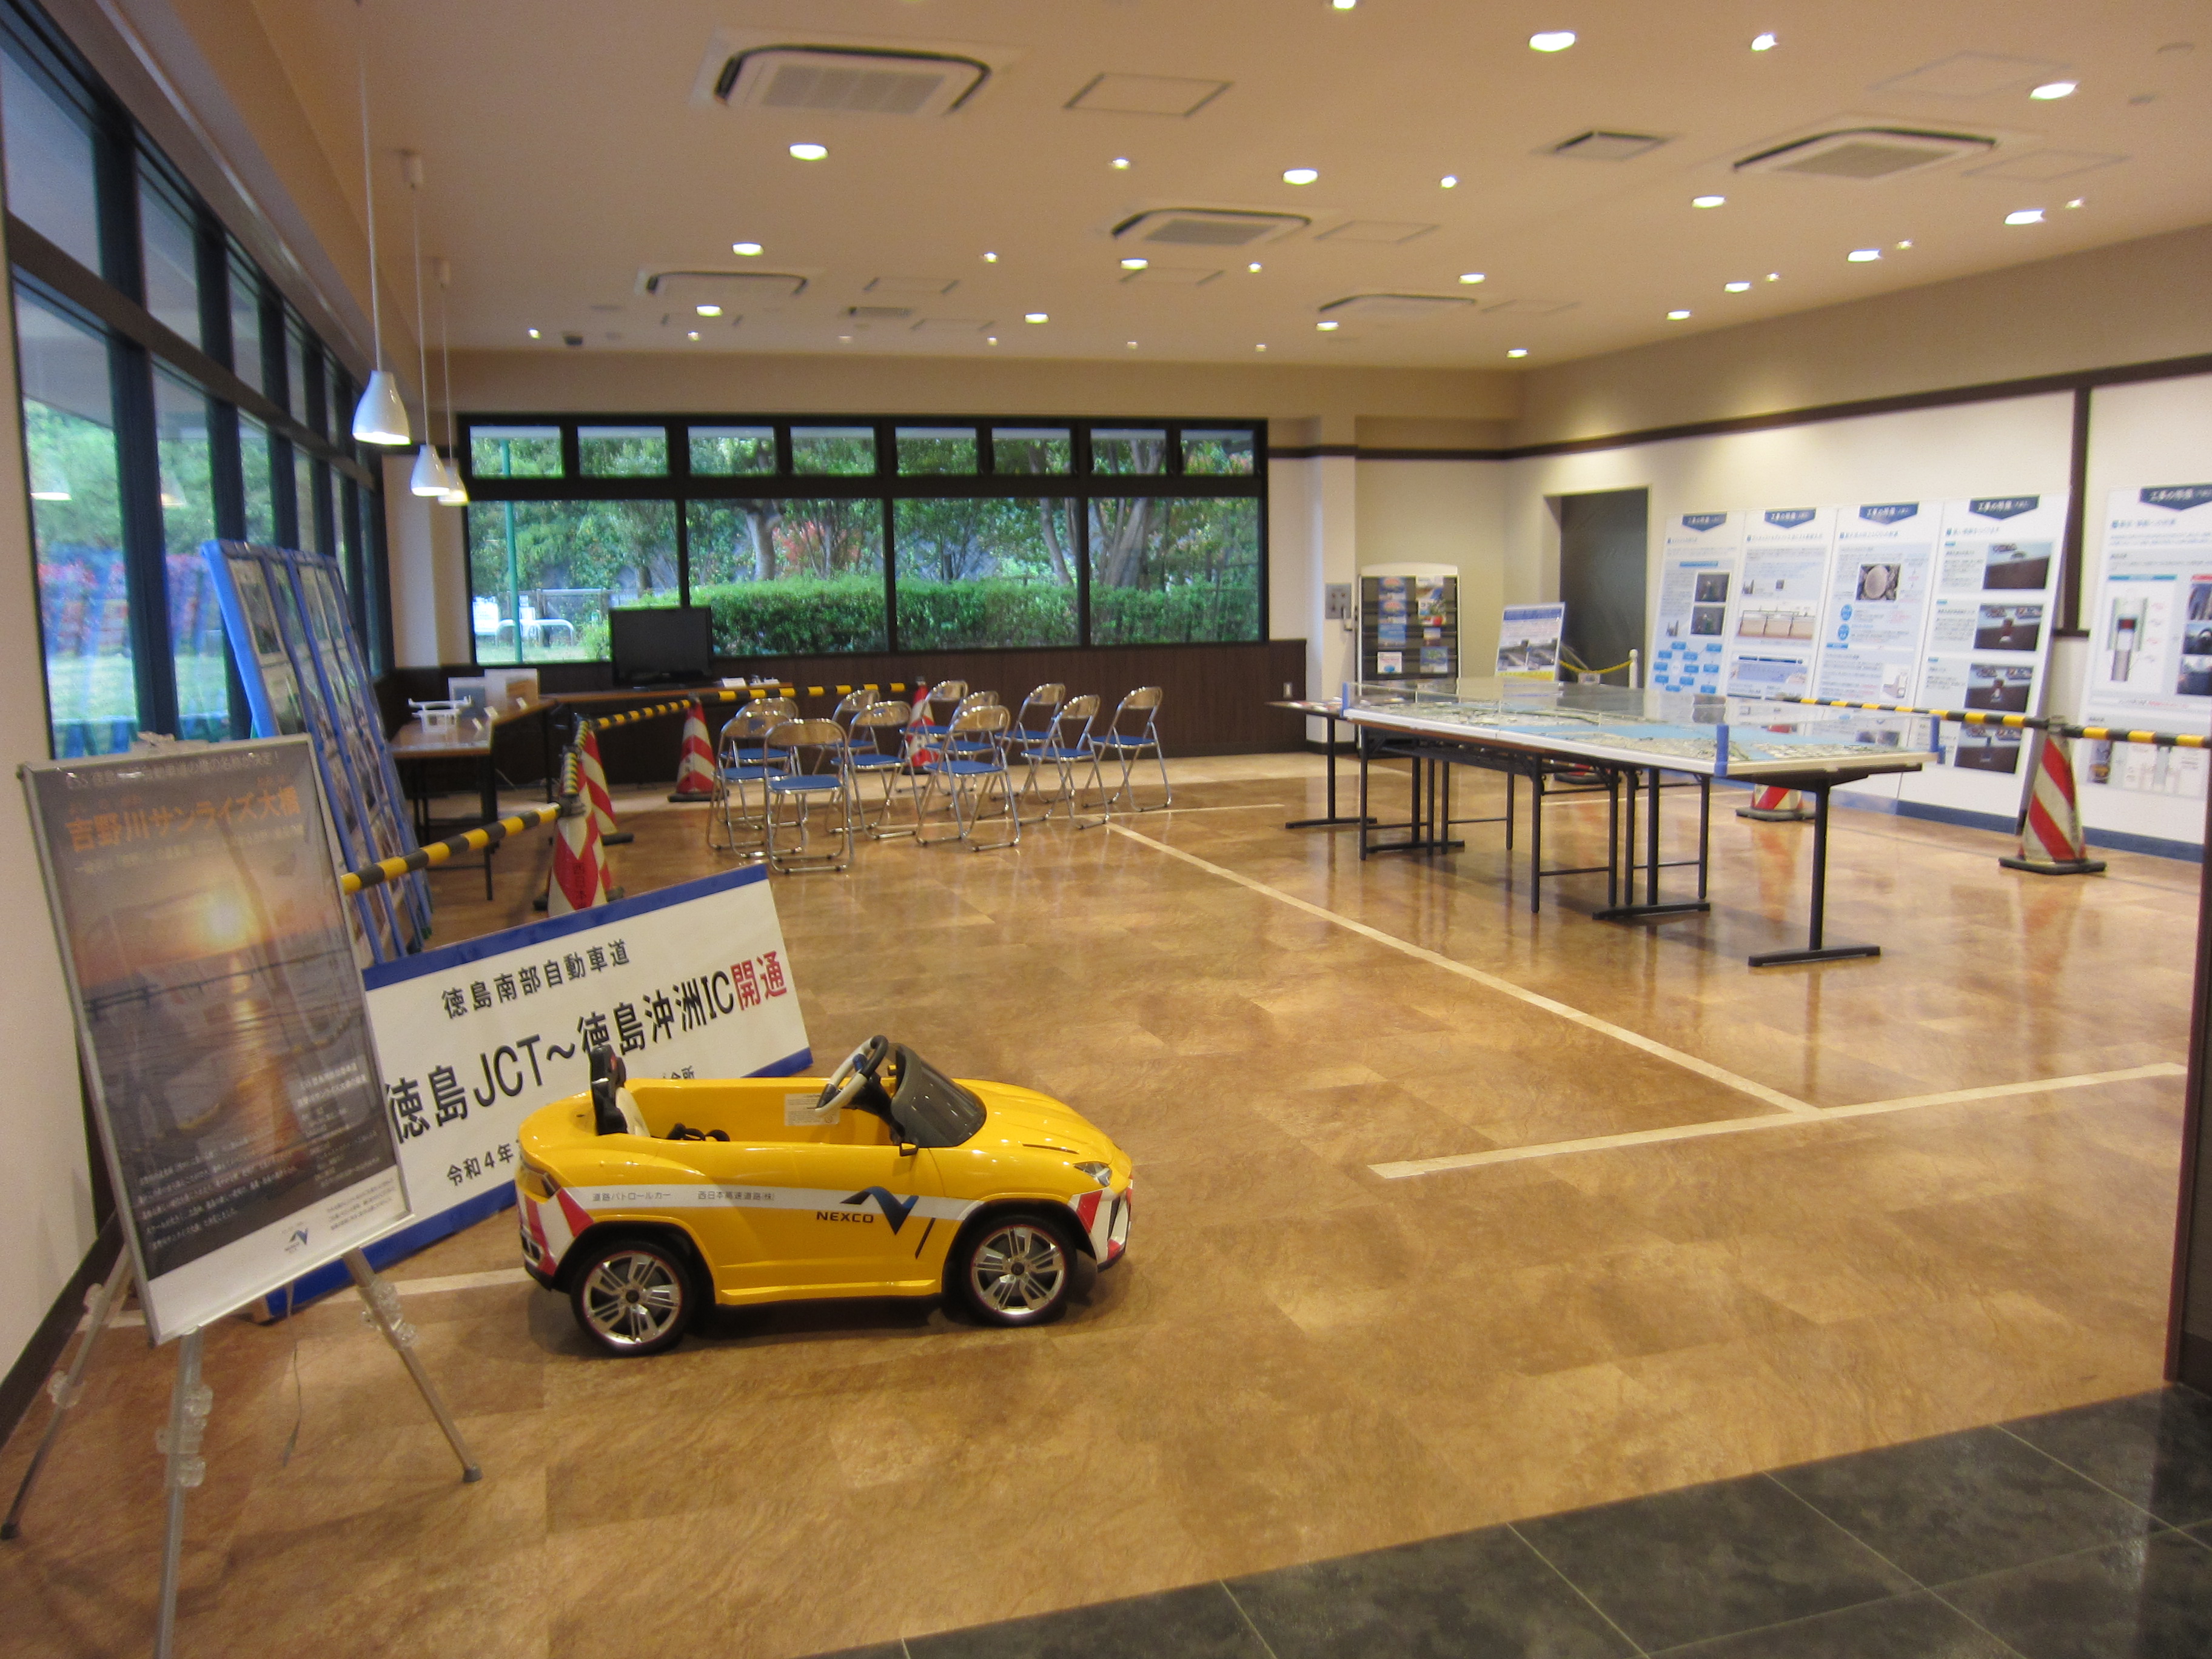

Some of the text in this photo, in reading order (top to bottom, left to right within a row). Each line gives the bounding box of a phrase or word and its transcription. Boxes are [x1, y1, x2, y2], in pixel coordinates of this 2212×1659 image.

[65, 786, 301, 853] 吉野川サンライズ大橋
[441, 938, 631, 1020] 徳島南部自動車道
[446, 1139, 520, 1186] 令和4年
[592, 1191, 671, 1202] 道路パトロールカー
[816, 1211, 874, 1224] NEXCO
